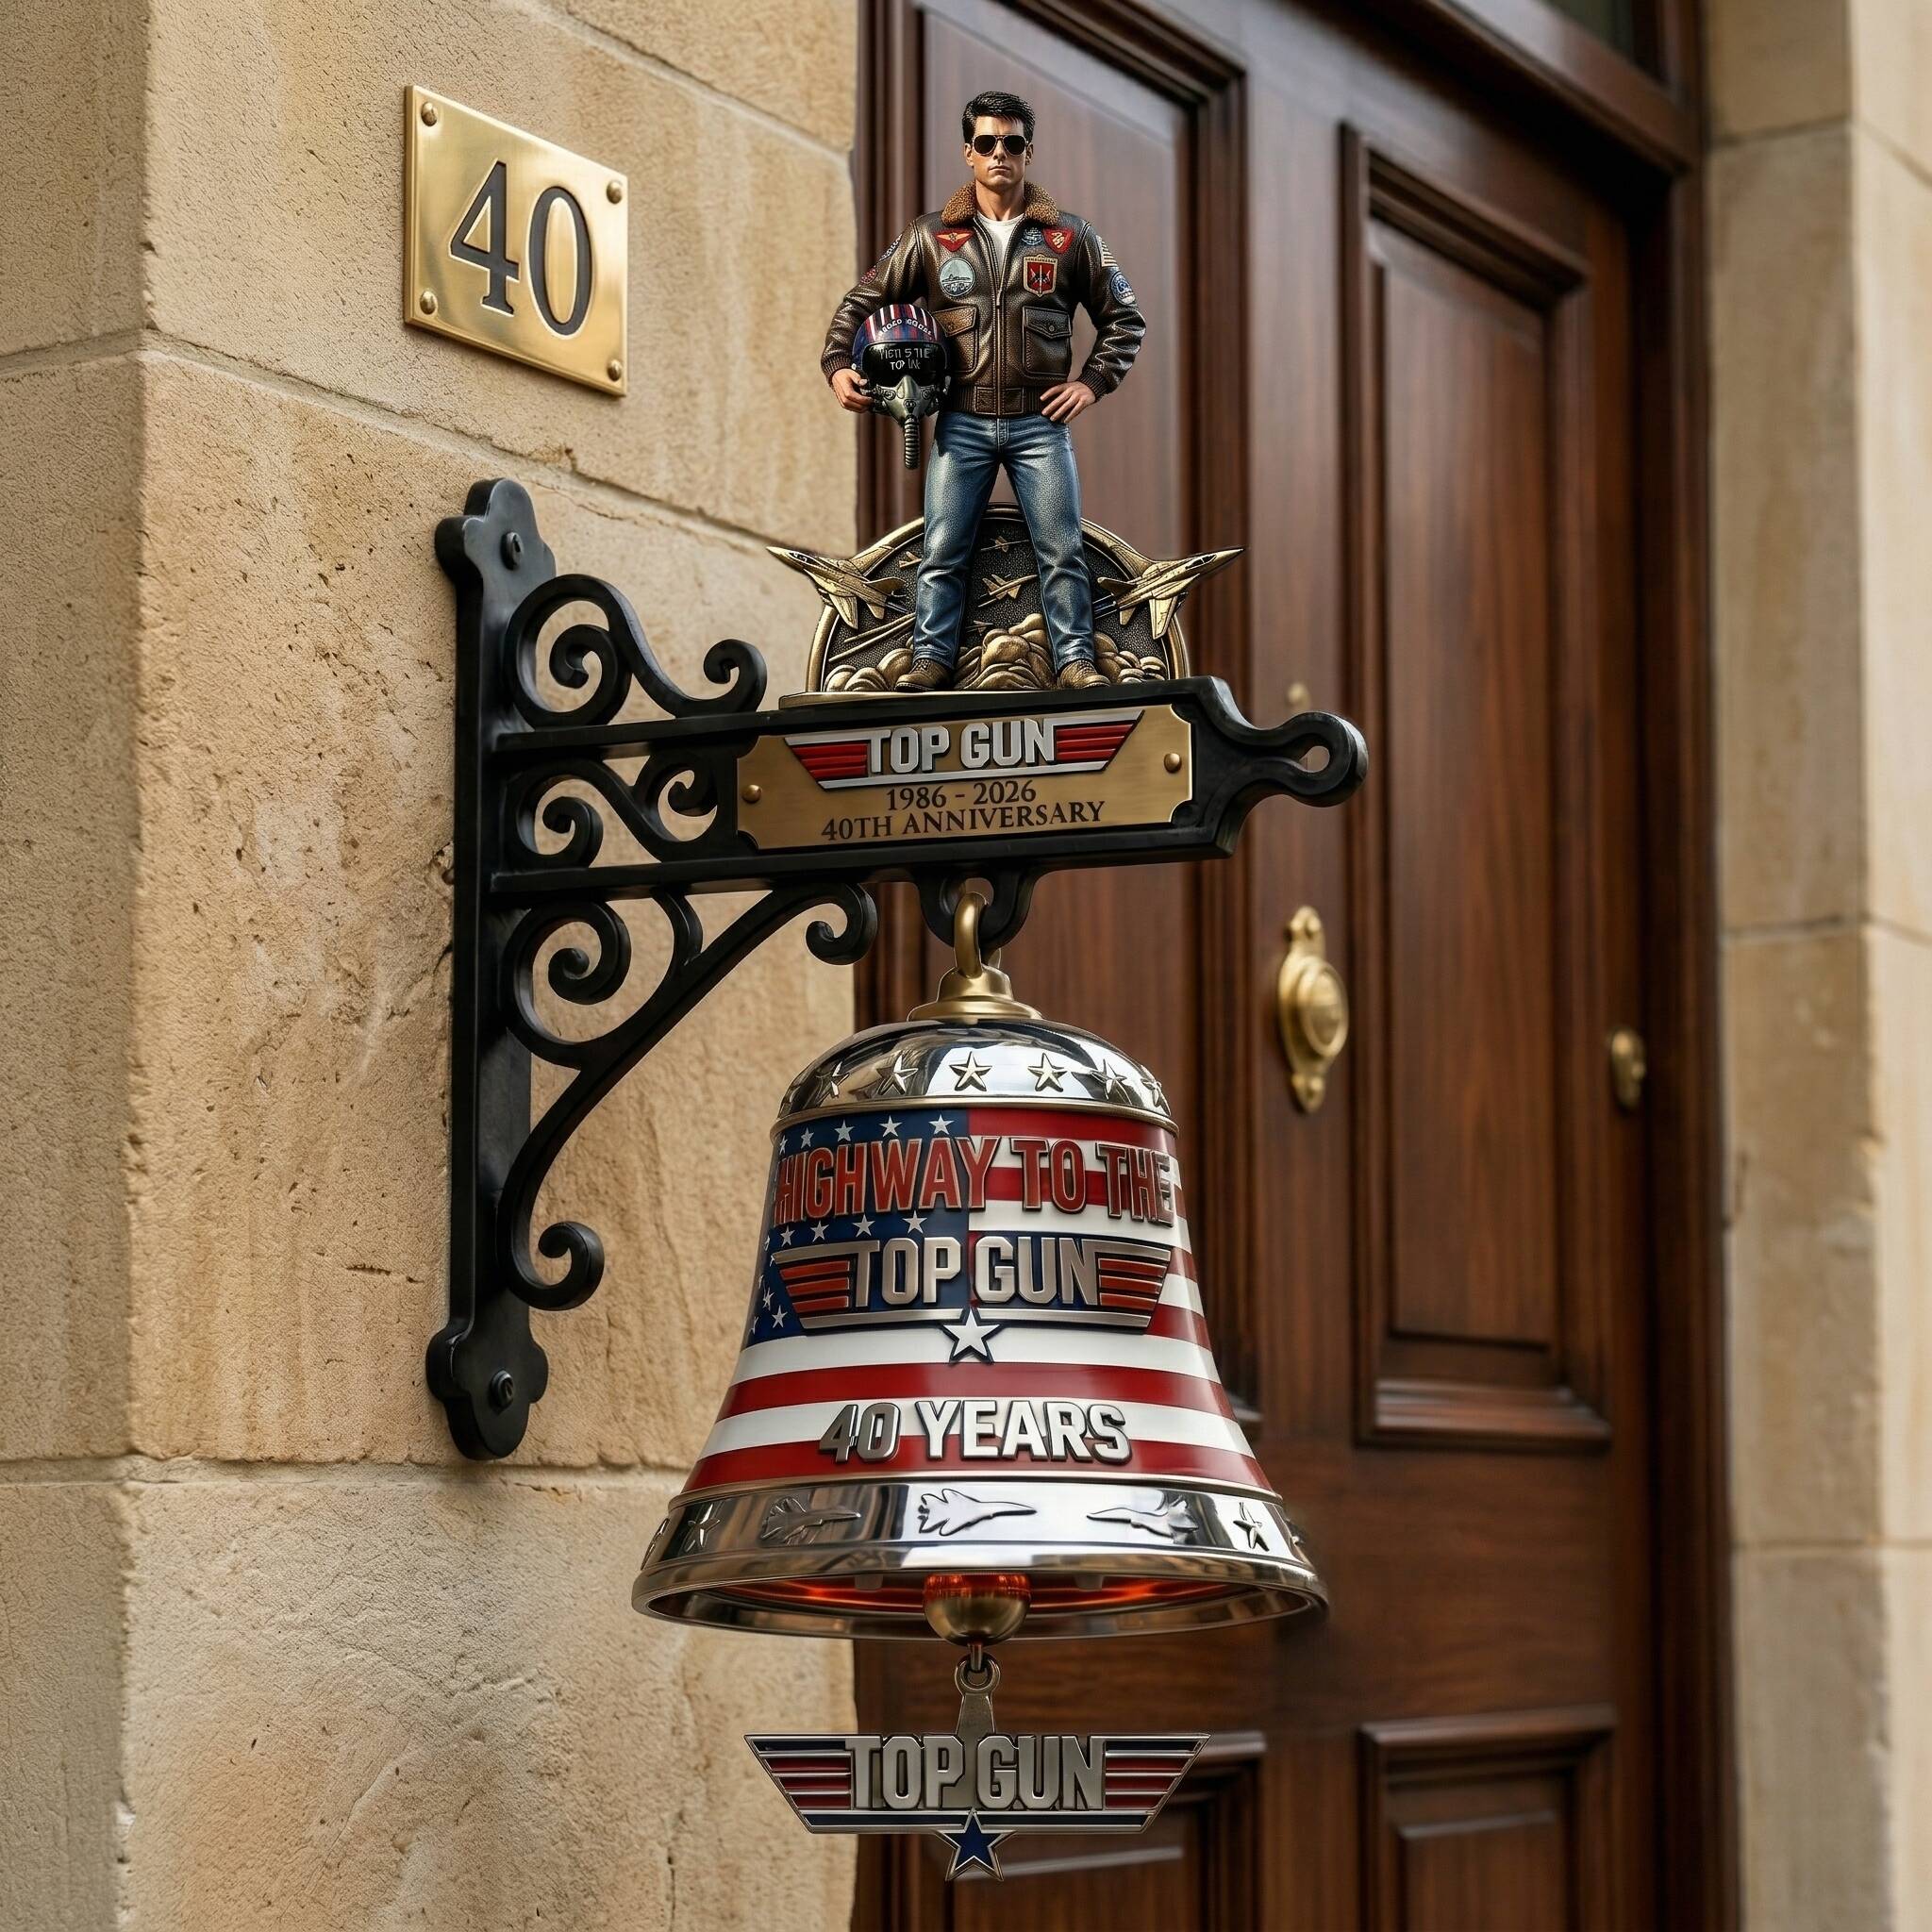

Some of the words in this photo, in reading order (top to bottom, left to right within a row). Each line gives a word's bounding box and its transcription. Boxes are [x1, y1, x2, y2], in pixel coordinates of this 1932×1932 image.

[449, 159, 594, 338] 40
[866, 724, 950, 774] TOP
[960, 717, 1057, 769] GUN
[821, 815, 892, 841] 40TH
[902, 800, 1106, 835] ANNIVERSARY
[887, 786, 947, 811] 1986
[973, 779, 1038, 805] 2026
[774, 1135, 1003, 1227] HIGHWAY
[1009, 1136, 1087, 1215] TO
[1094, 1141, 1175, 1227] THE
[847, 1236, 962, 1308] TOP
[973, 1235, 1101, 1307] GUN
[817, 1402, 901, 1463] 40
[914, 1399, 1134, 1466] YEARS
[845, 1733, 966, 1811] TOP
[975, 1733, 1108, 1811] GUN
